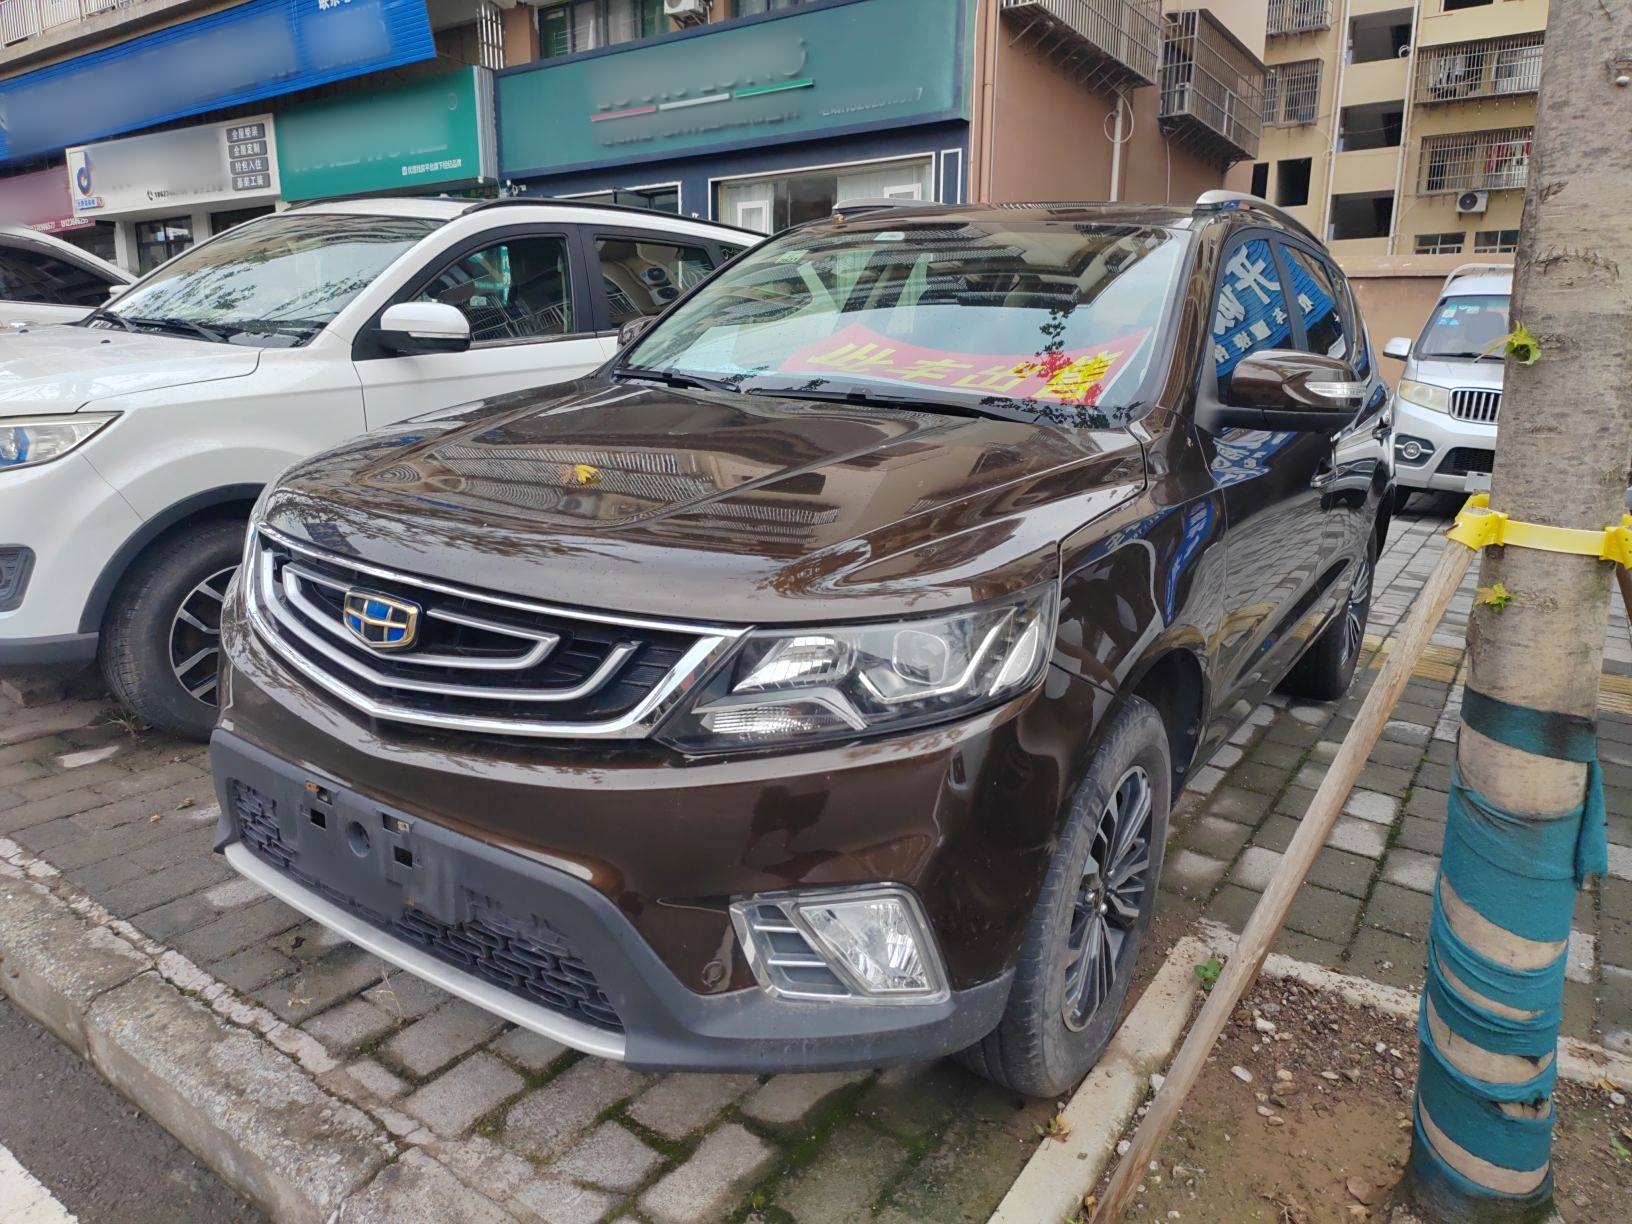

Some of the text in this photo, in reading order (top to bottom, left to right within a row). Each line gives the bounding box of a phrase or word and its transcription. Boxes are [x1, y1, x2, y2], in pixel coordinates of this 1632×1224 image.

[235, 158, 262, 172] 拎包入住
[807, 343, 1123, 401] 此车出售
